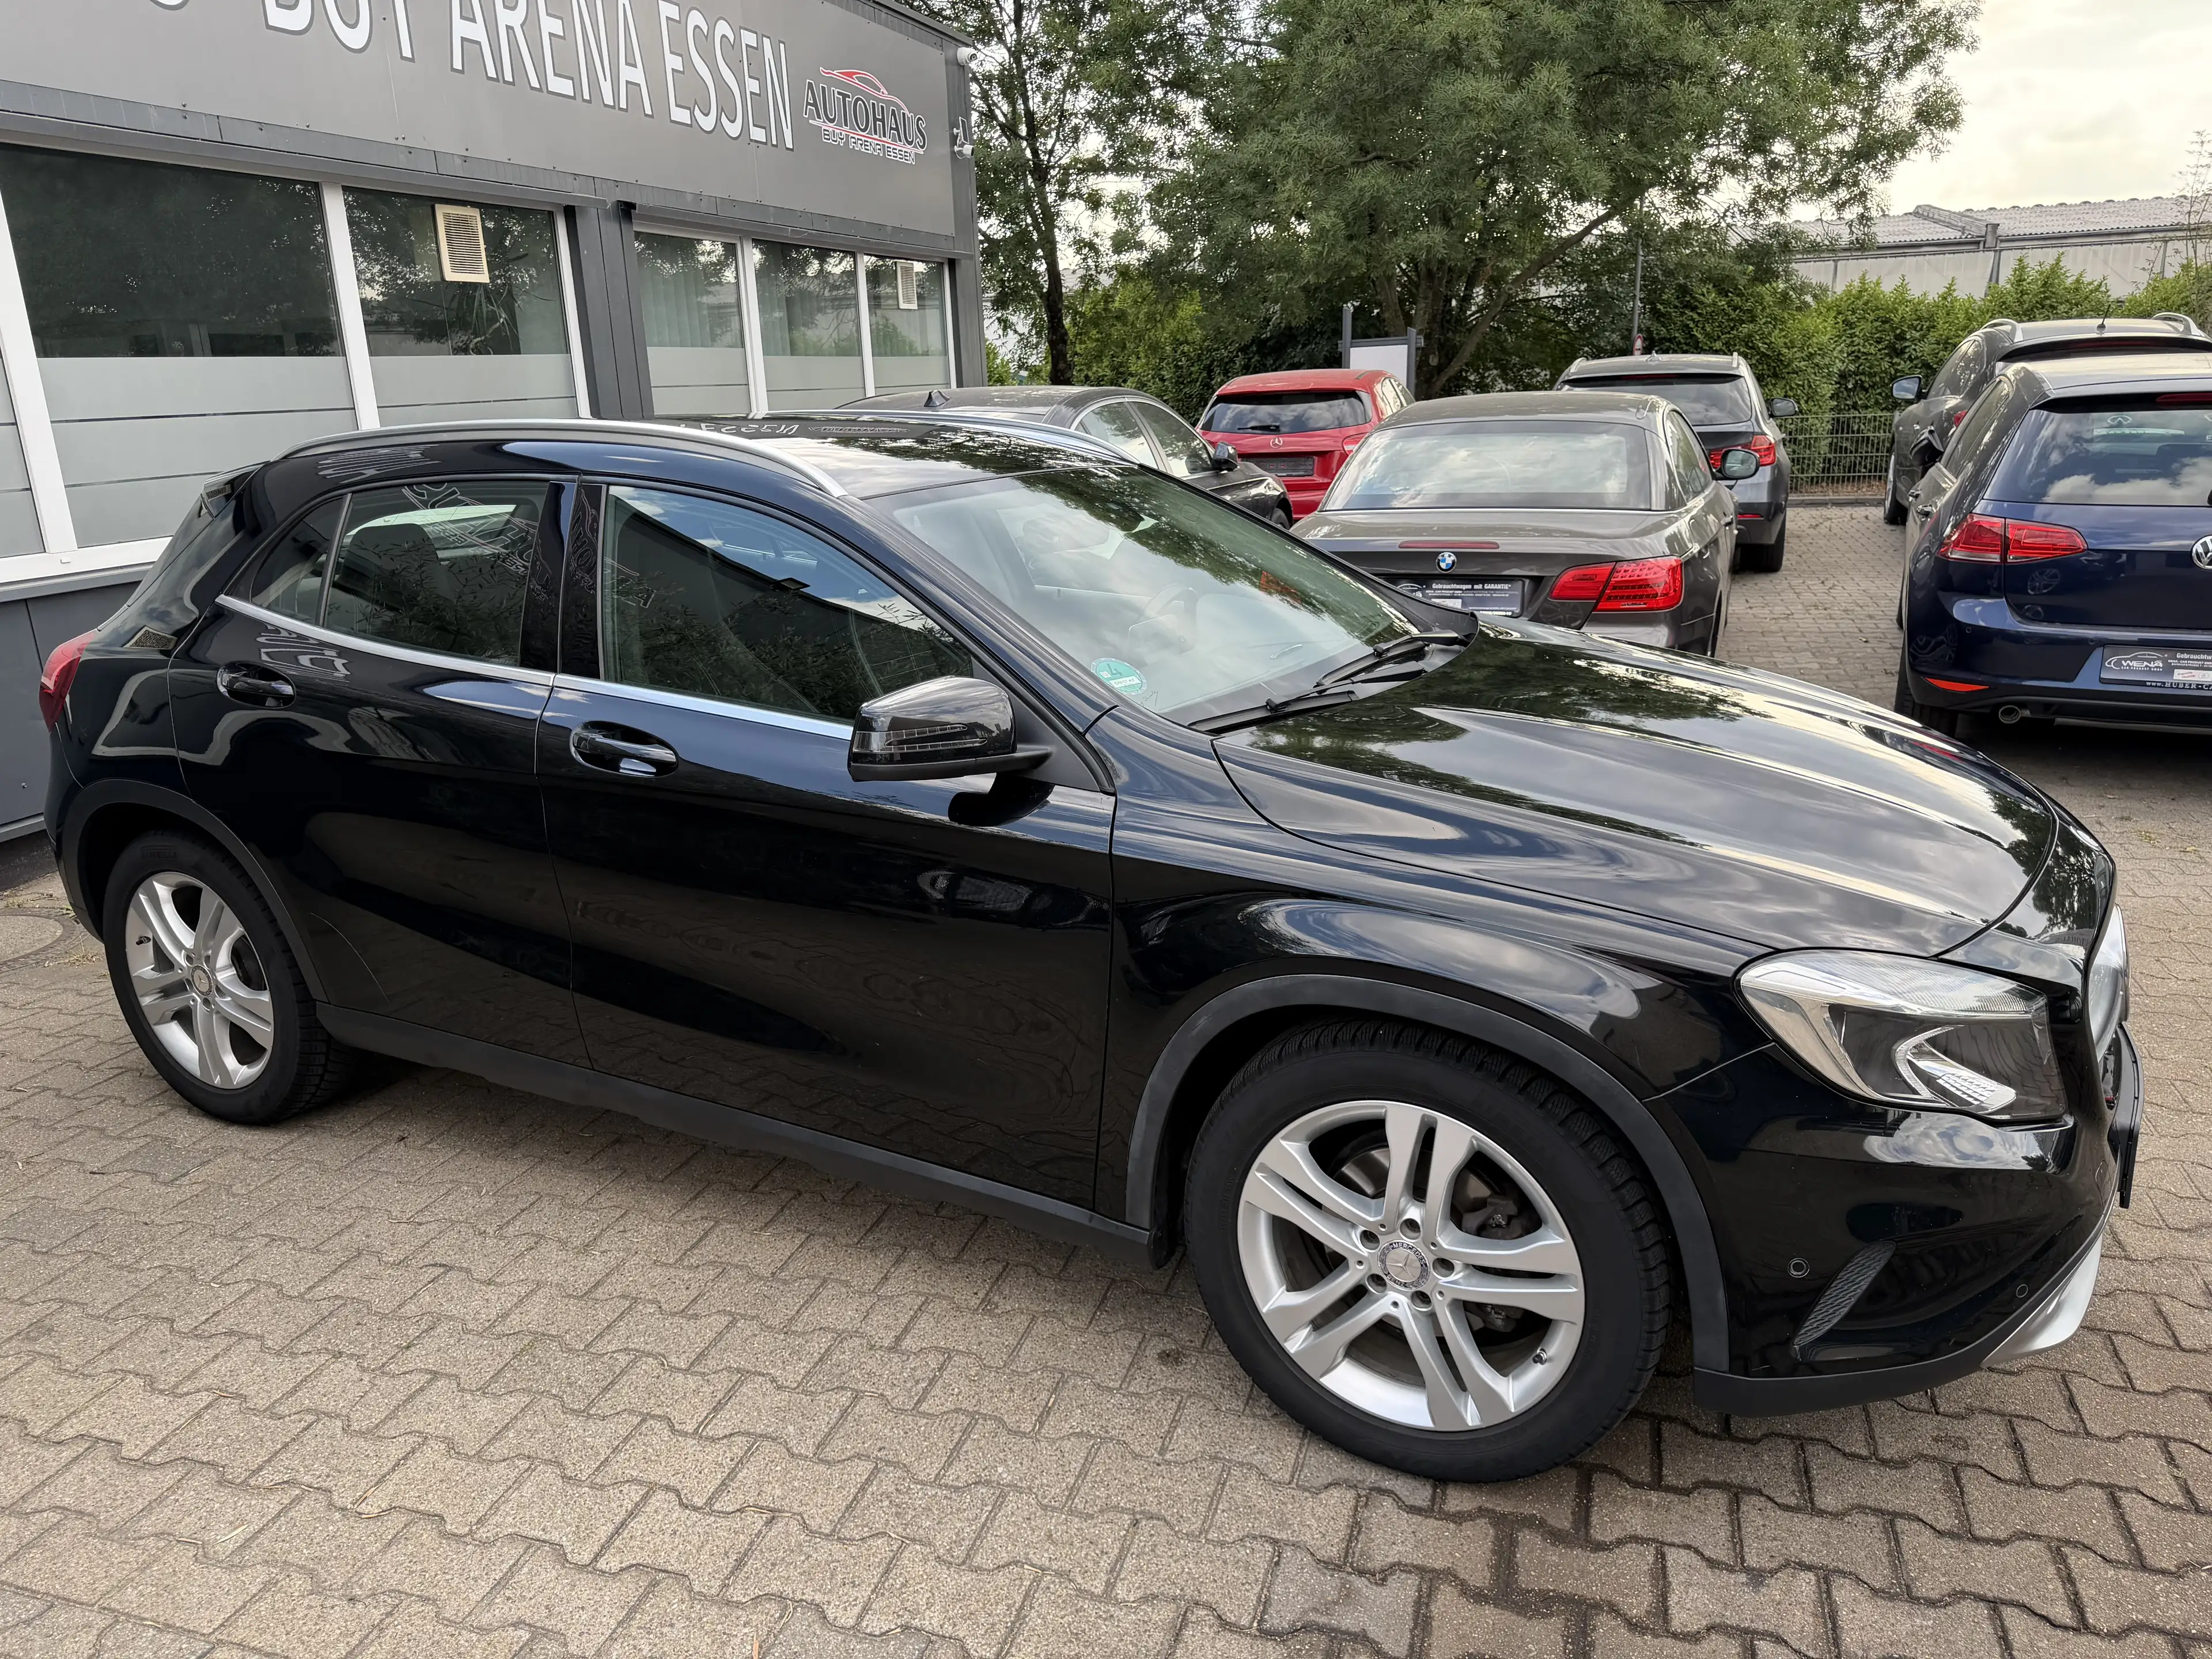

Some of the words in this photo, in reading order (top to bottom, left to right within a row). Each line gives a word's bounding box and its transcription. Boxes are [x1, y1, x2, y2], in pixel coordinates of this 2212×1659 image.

[450, 0, 654, 119] ARENA
[658, 0, 794, 152] ESSEN
[804, 79, 927, 151] AUTOHAUS
[821, 126, 846, 146] BUY
[849, 135, 883, 156] ARENA
[885, 144, 916, 165] ESSEN
[1393, 1242, 1426, 1265] MERCEDES
[1387, 1274, 1407, 1287] BENZ
